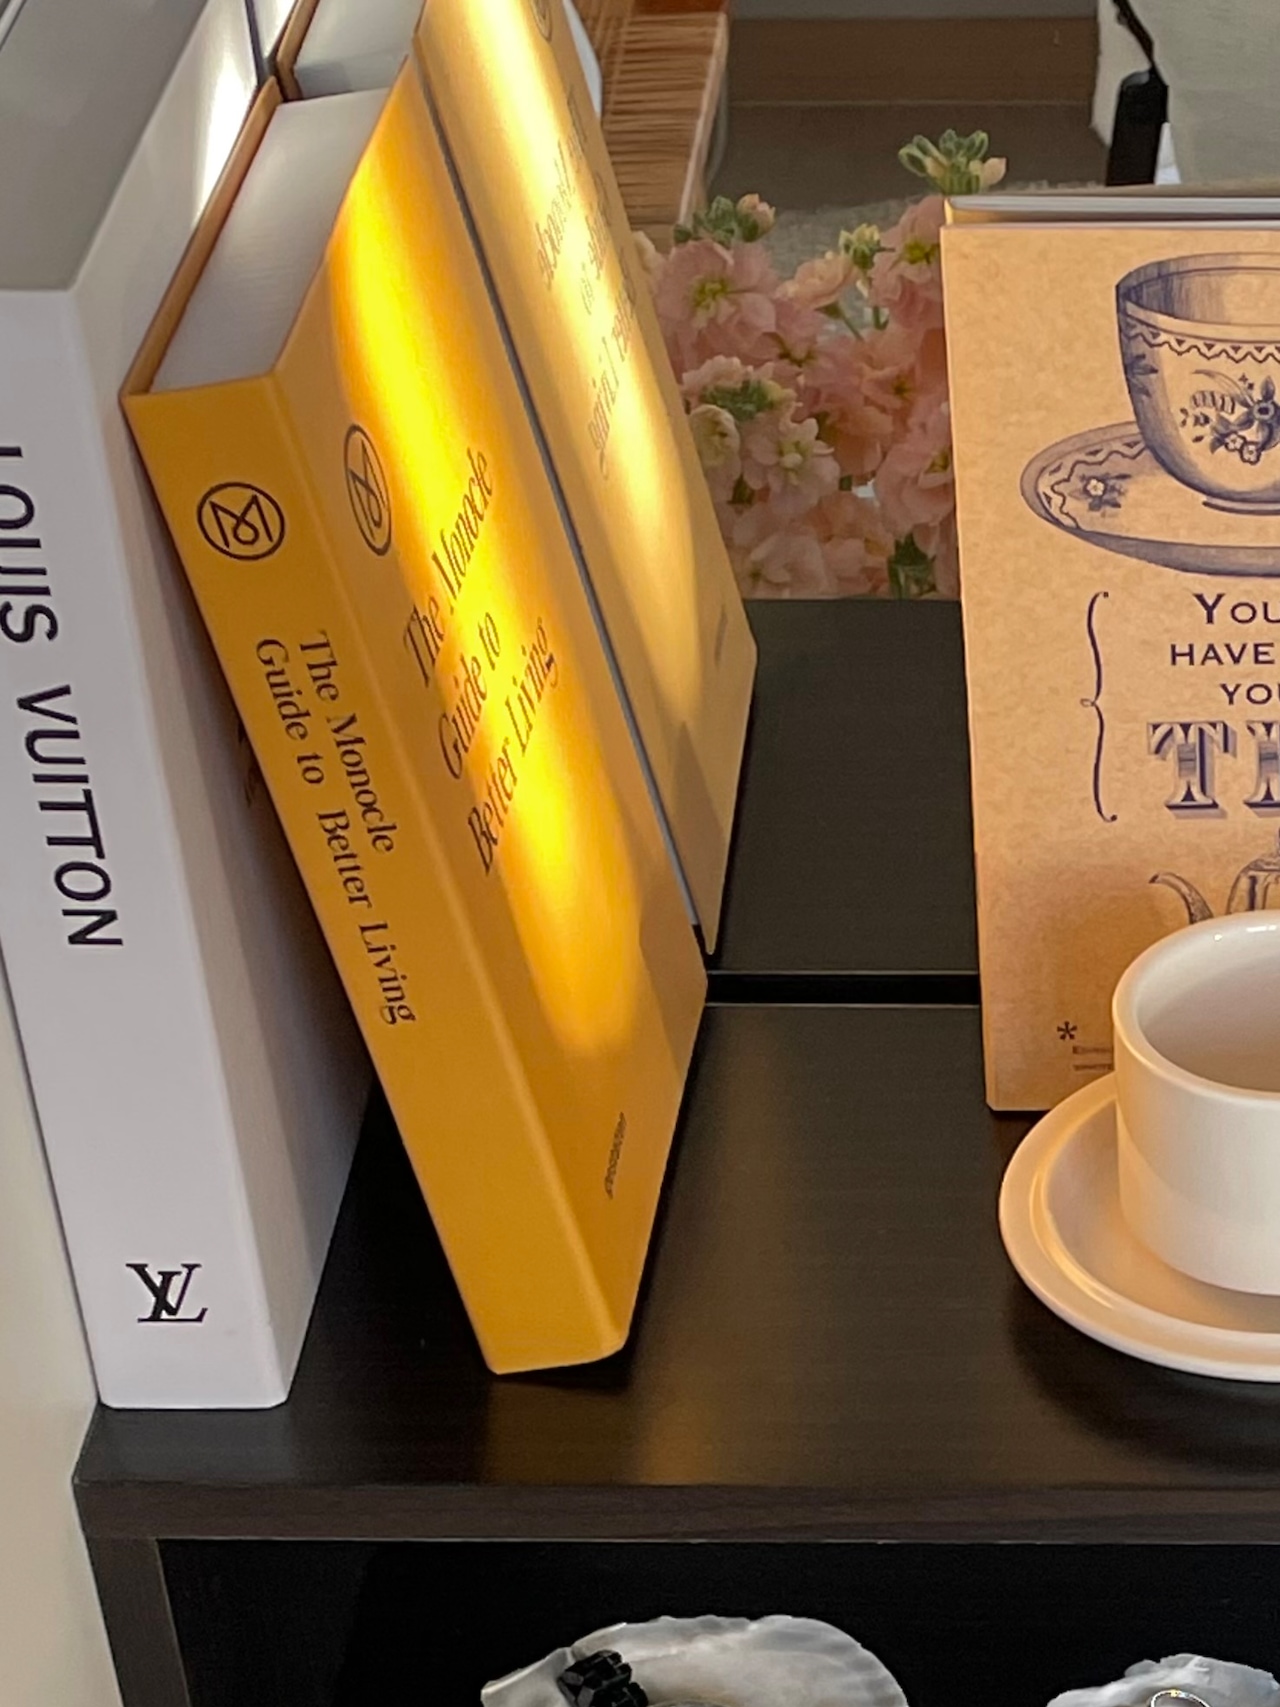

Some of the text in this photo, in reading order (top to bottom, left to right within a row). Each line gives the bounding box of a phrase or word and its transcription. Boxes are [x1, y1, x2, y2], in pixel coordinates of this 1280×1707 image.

[403, 447, 495, 688] The Monocle
[1169, 643, 1276, 666] HAVE
[16, 684, 124, 947] VUITTON
[300, 629, 396, 853] The Monocle
[437, 610, 502, 782] Guide to
[466, 617, 560, 877] Better Living
[256, 638, 416, 1026] Guide to Better Living
